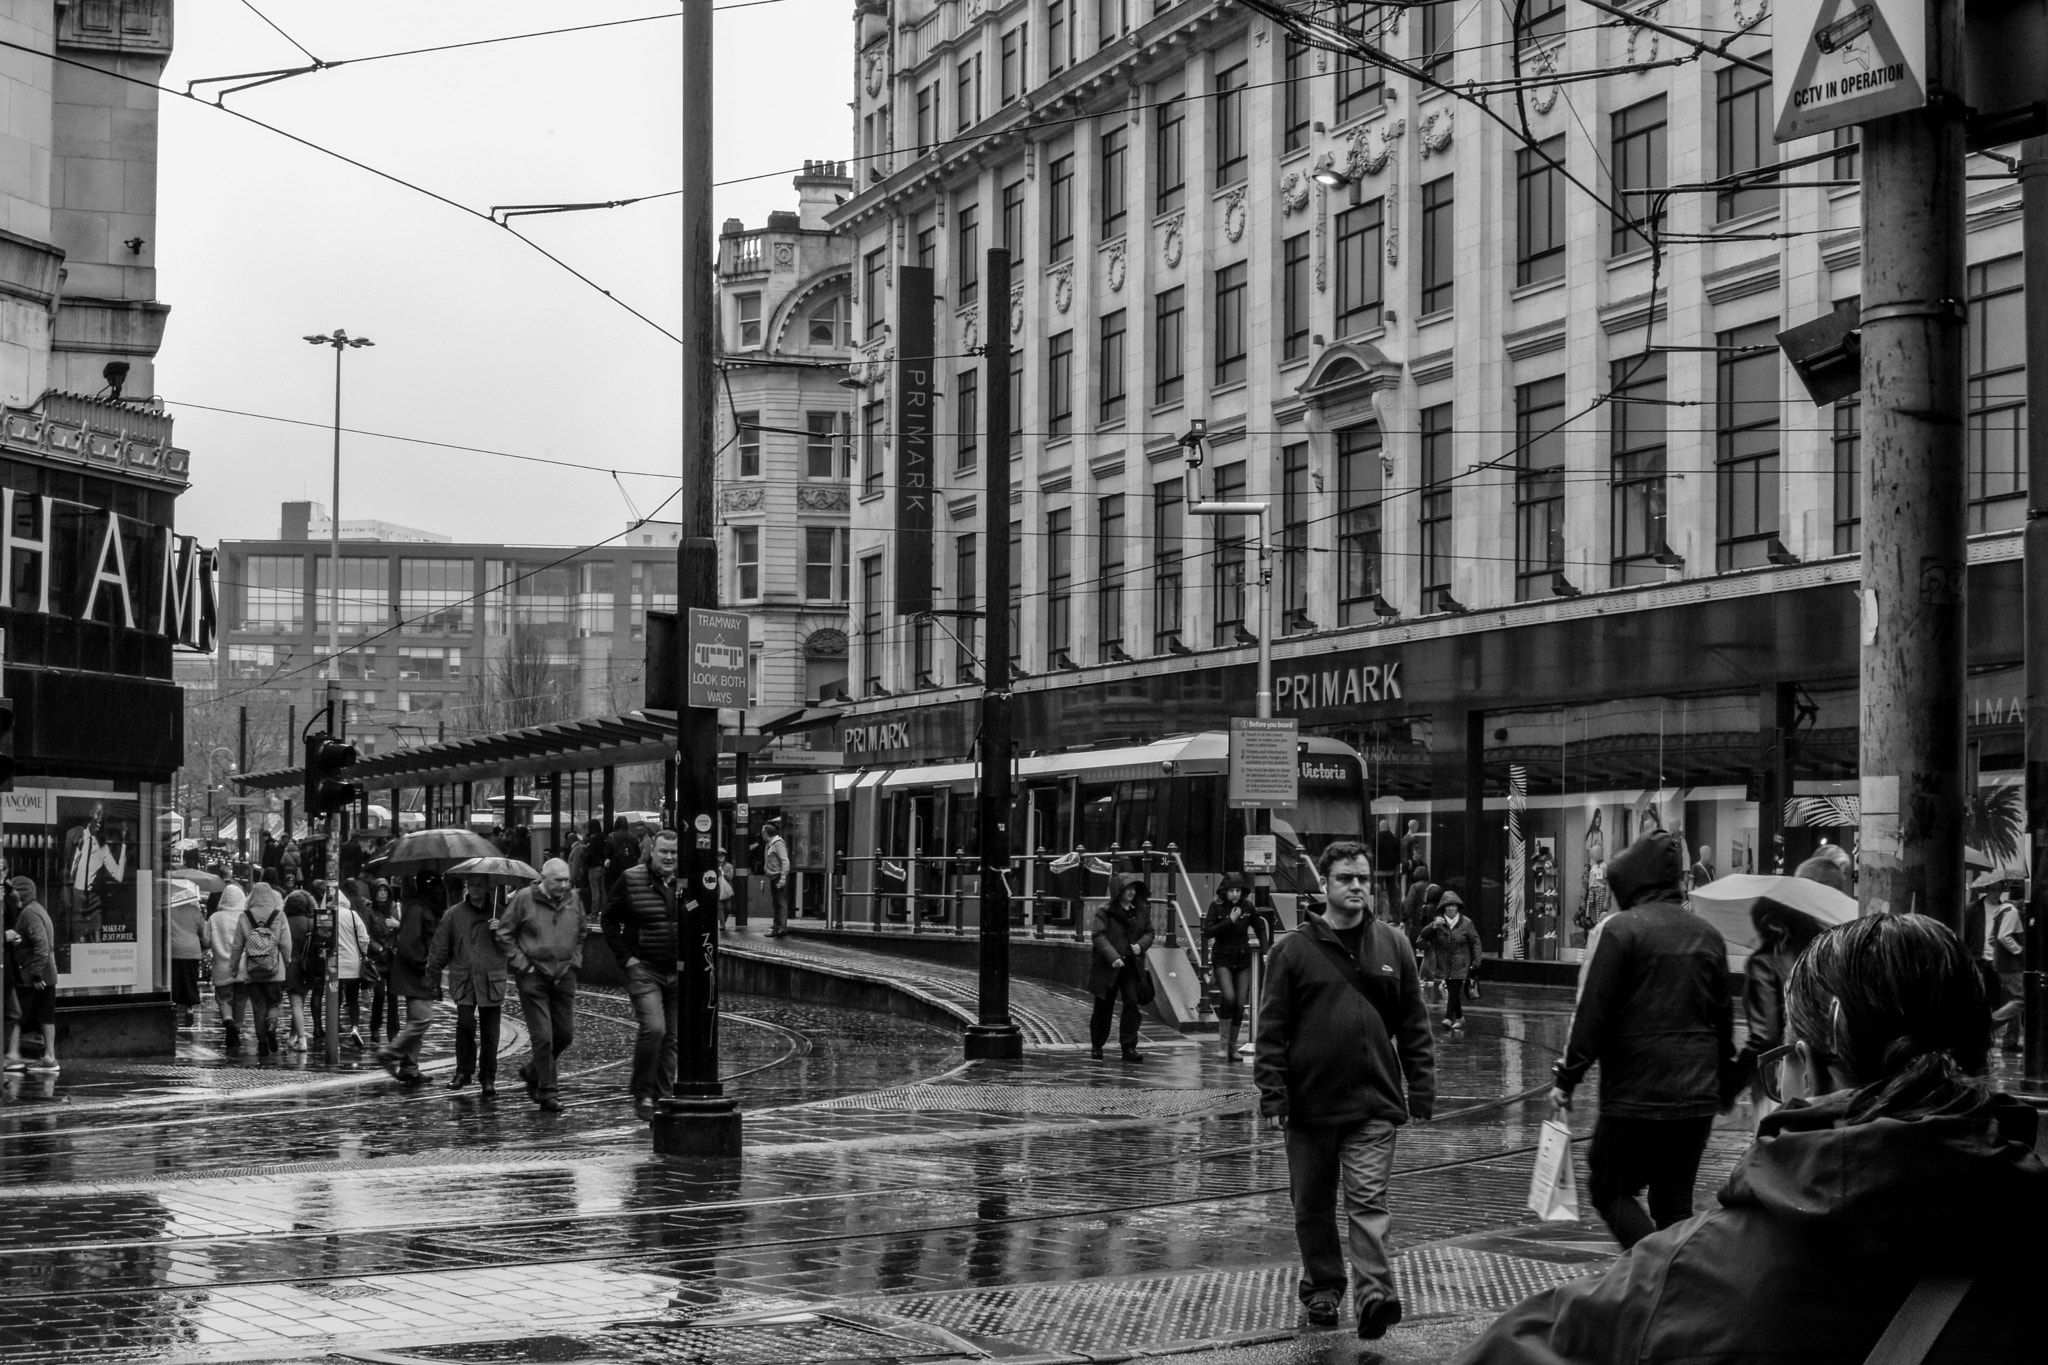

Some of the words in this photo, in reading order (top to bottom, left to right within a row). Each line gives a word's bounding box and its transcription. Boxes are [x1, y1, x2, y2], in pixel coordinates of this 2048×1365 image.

[1794, 84, 1823, 108] CCTV
[1826, 80, 1837, 99] IN
[1840, 63, 1904, 95] OPERATION
[907, 369, 927, 511] PRIMARK
[0, 487, 220, 653] HAMS
[697, 614, 742, 631] TRAMWAY
[693, 672, 719, 686] LOOK
[720, 675, 746, 689] BOTH
[1276, 662, 1402, 712] PRIMARK
[706, 690, 733, 704] WAYS
[1975, 697, 2024, 726] IMA
[1248, 720, 1267, 728] Before
[1267, 722, 1277, 730] you
[1277, 721, 1293, 729] board
[844, 721, 910, 754] PRIMARK
[1302, 762, 1346, 780] Victoria
[102, 924, 126, 932] MAKE-UP
